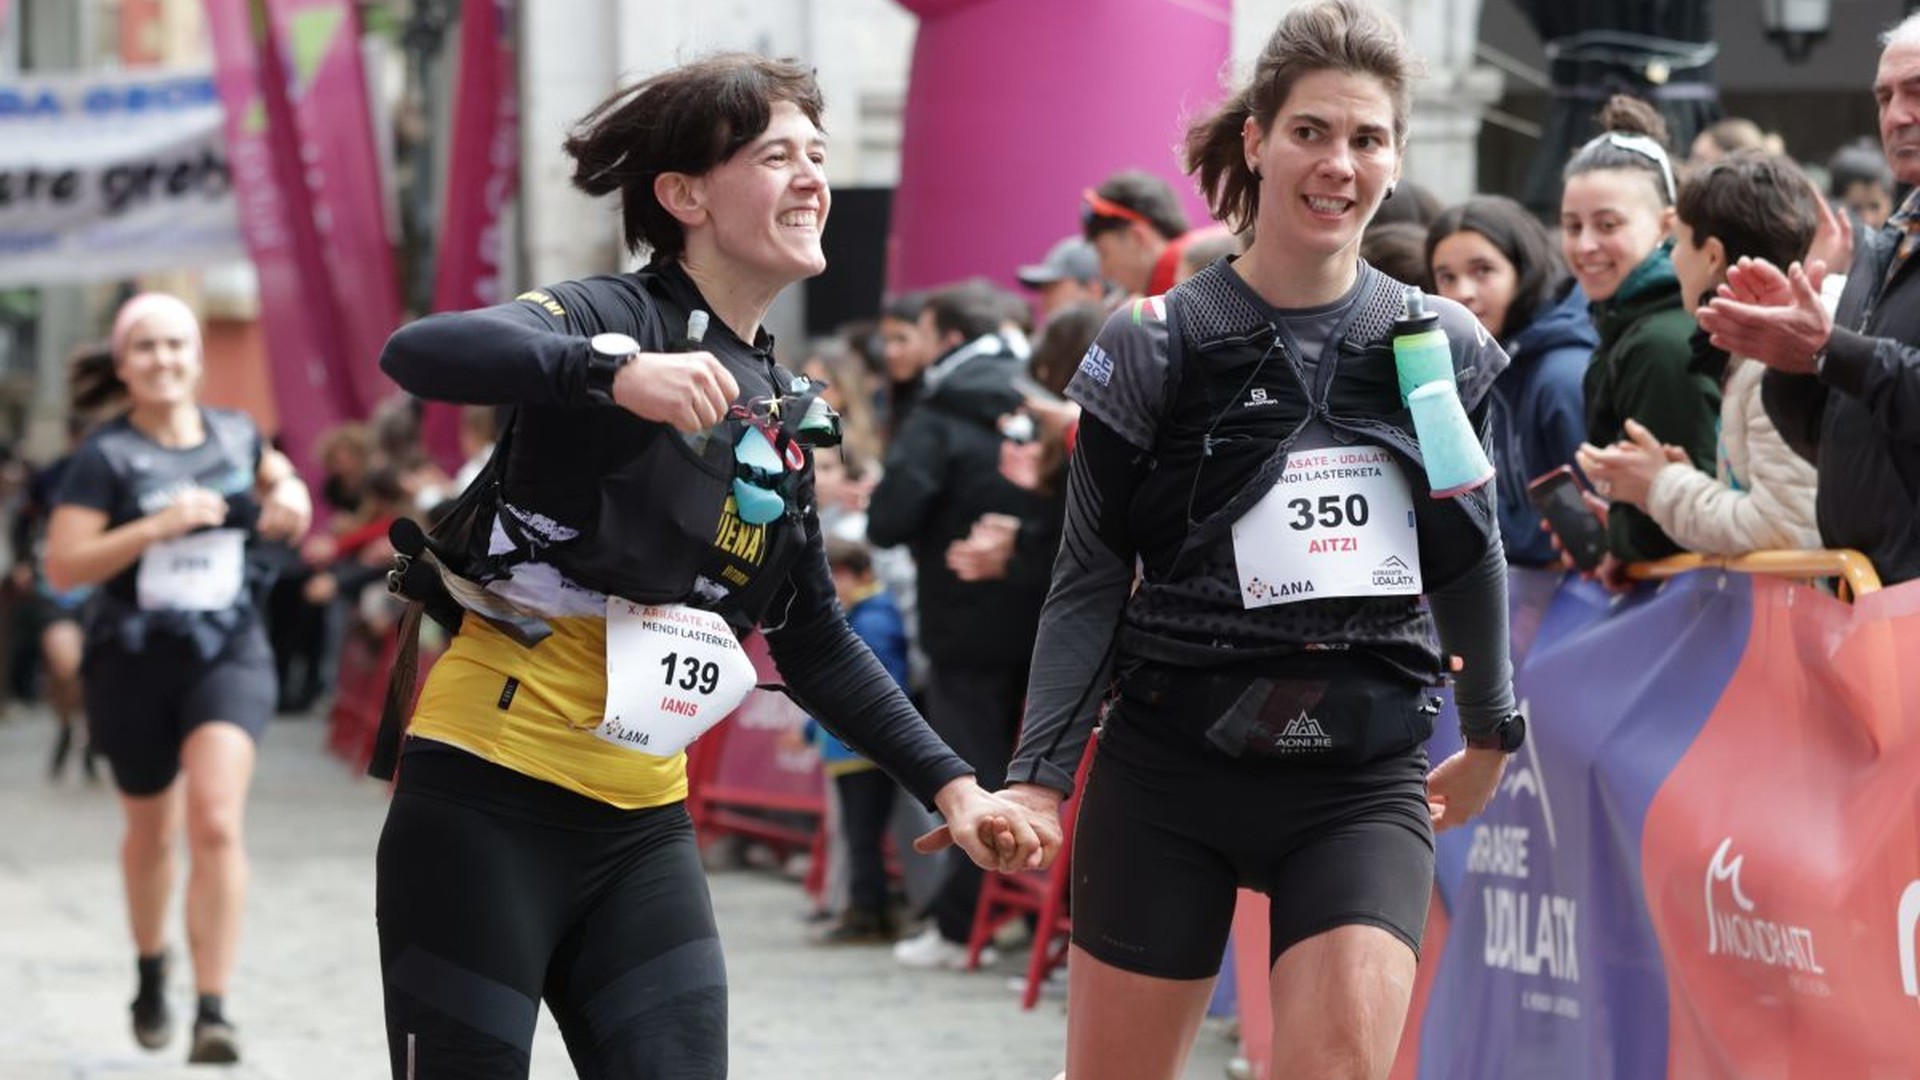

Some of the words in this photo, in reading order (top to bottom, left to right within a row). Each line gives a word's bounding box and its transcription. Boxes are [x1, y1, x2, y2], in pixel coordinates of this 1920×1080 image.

[1306, 466, 1382, 482] LASTERKETA
[1287, 493, 1370, 531] 350
[1308, 537, 1358, 554] AITZI
[1269, 580, 1315, 598] LANA
[642, 620, 679, 637] MENDI
[681, 627, 739, 651] LASTERKETA
[661, 651, 720, 695] 139
[659, 696, 699, 717] IANIS
[617, 727, 651, 746] LANA
